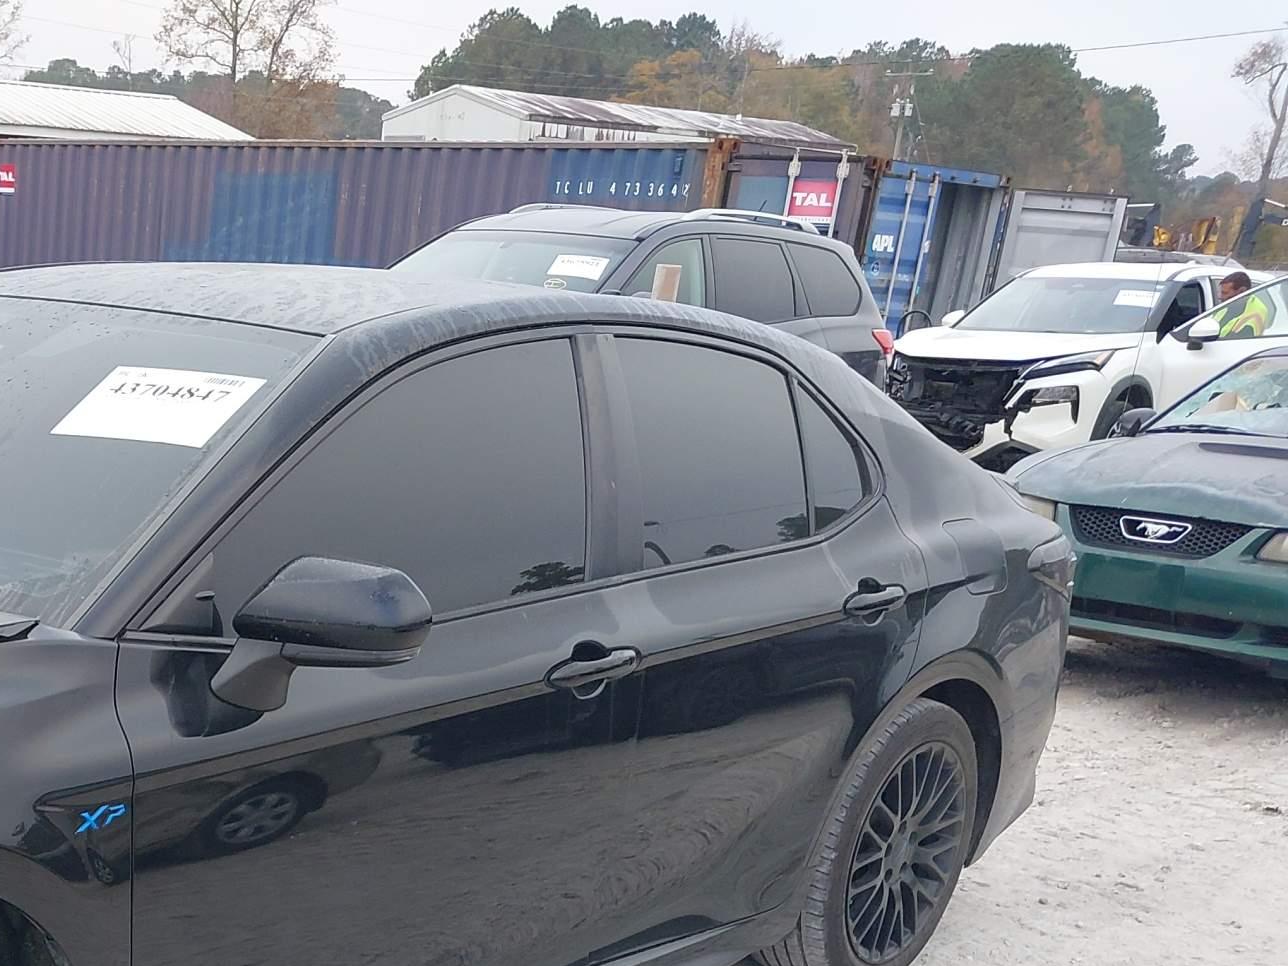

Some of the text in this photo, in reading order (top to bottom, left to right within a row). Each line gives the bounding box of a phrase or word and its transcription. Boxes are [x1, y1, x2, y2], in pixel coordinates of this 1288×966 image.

[792, 191, 832, 207] TAL
[872, 234, 895, 252] APL
[109, 381, 233, 403] 43704847
[73, 804, 126, 835] XP
